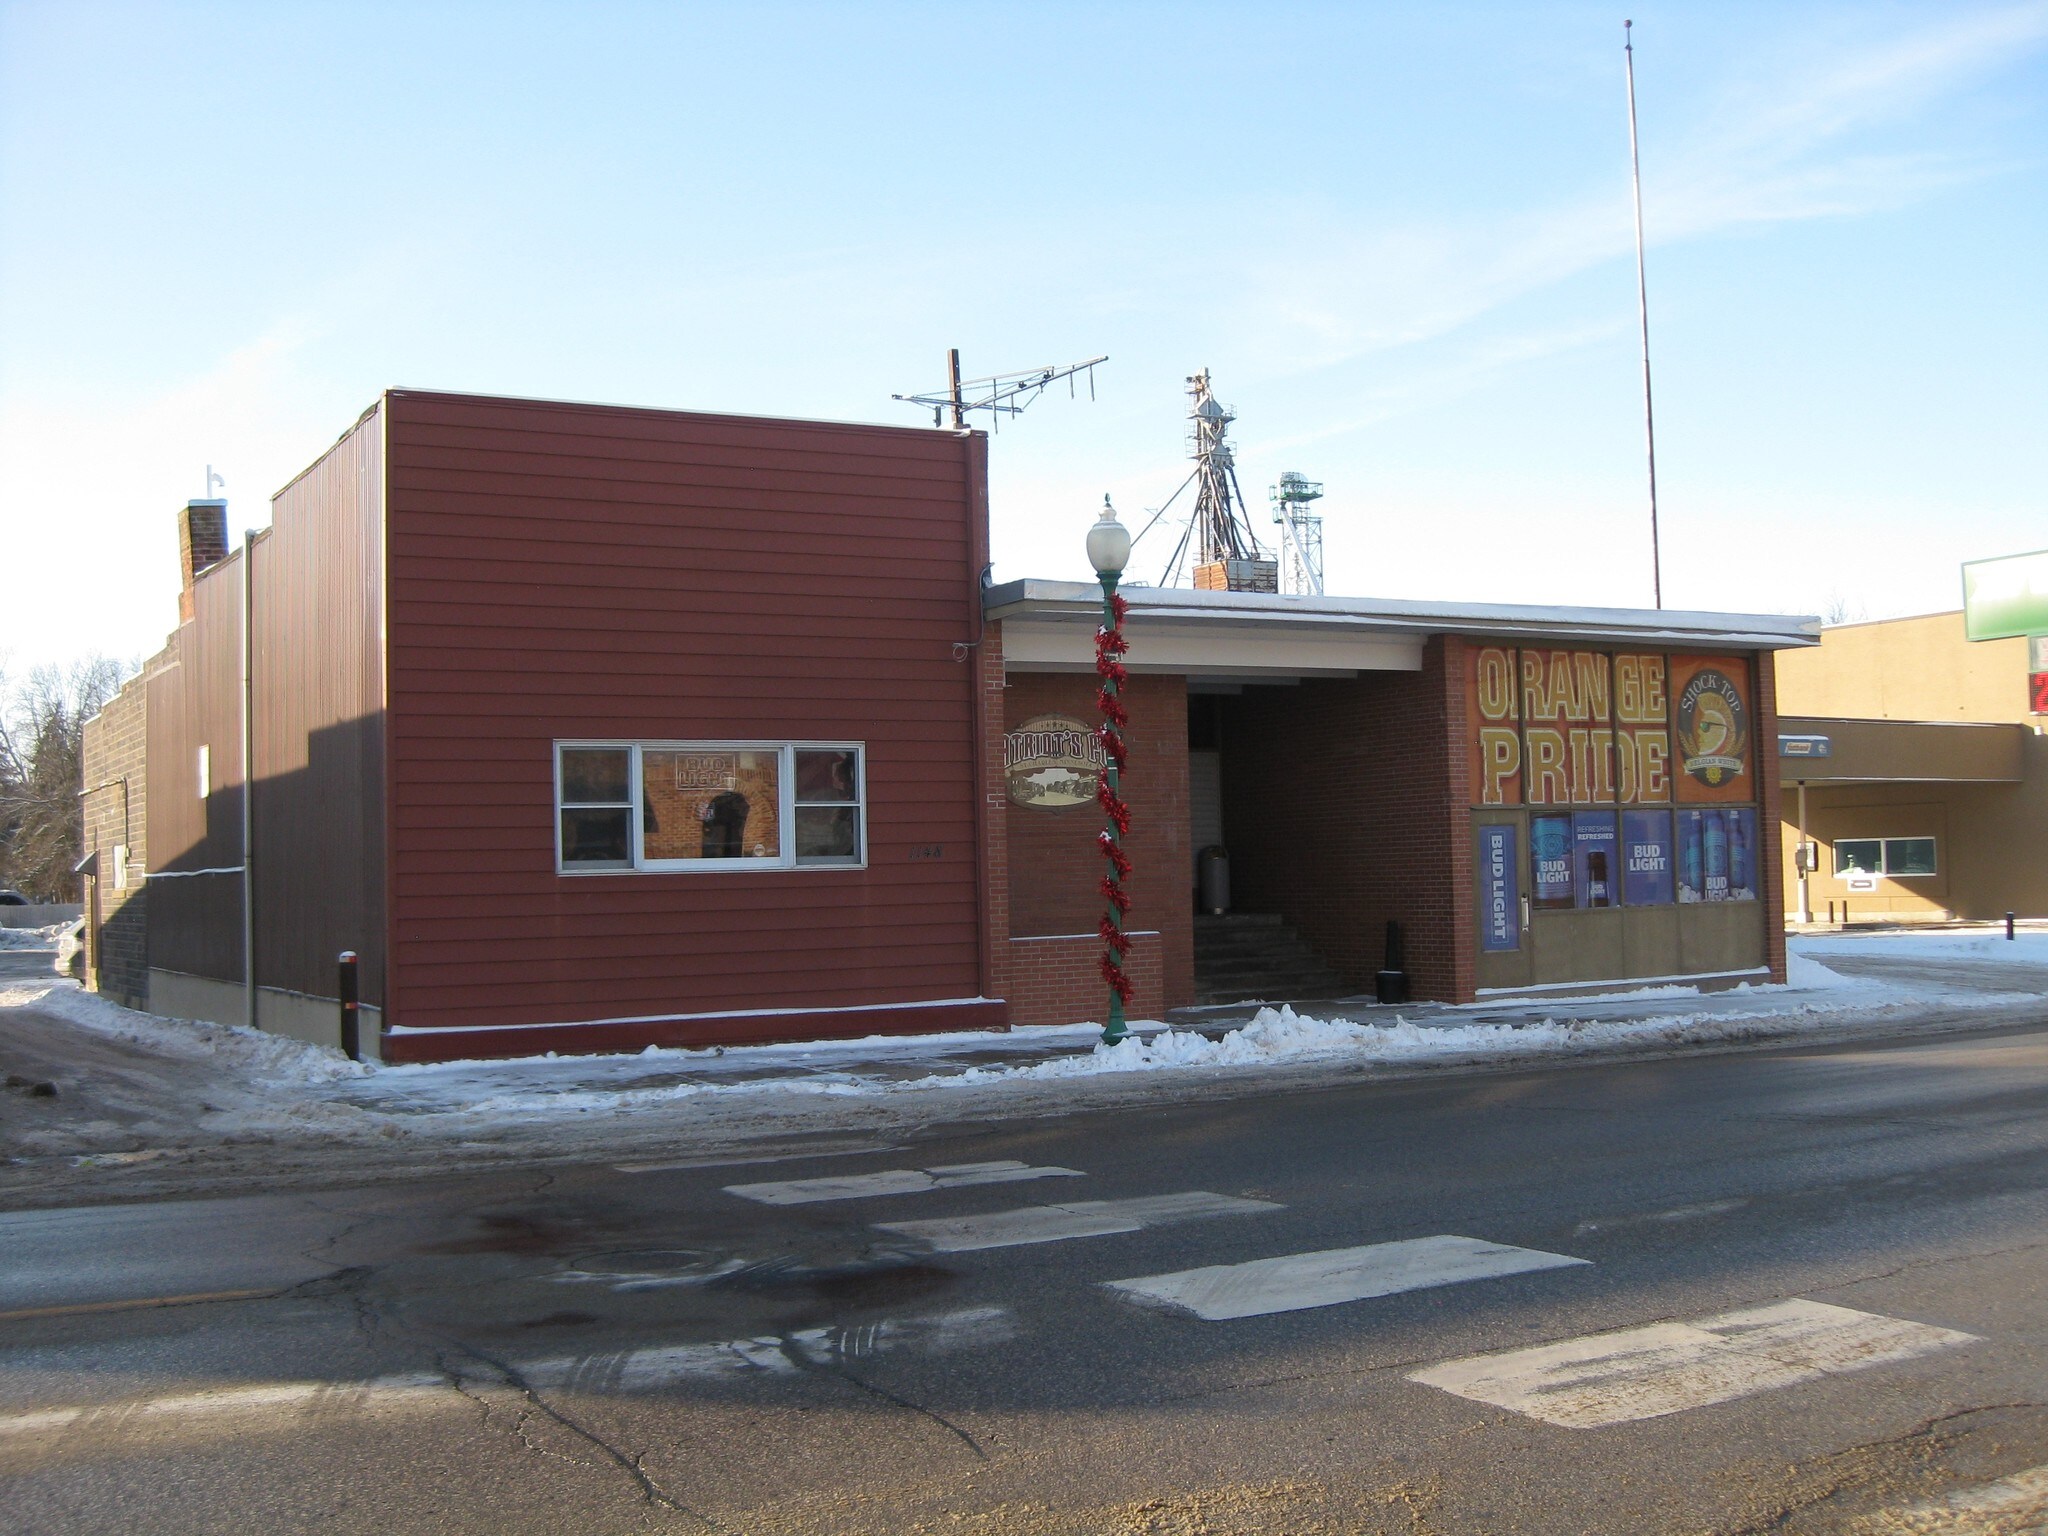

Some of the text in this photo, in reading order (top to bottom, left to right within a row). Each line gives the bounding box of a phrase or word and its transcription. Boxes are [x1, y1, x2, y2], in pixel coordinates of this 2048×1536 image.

[1478, 648, 1667, 723] ORANGE
[1682, 674, 1740, 712] SHOCK TOP
[1003, 730, 1083, 768] ATRIOT'S
[686, 756, 726, 771] BUD
[1479, 727, 1671, 804] PRIDE
[679, 771, 733, 788] LIGHT
[1577, 825, 1614, 833] REFRESHING
[1577, 832, 1614, 840] REFRESHED
[1633, 844, 1661, 858] BUD
[1540, 860, 1566, 872] BUD
[1629, 857, 1666, 871] LIGHT
[1536, 871, 1571, 883] LIGHT
[1706, 876, 1728, 889] BUD
[1491, 835, 1506, 939] BUD LIGHT
